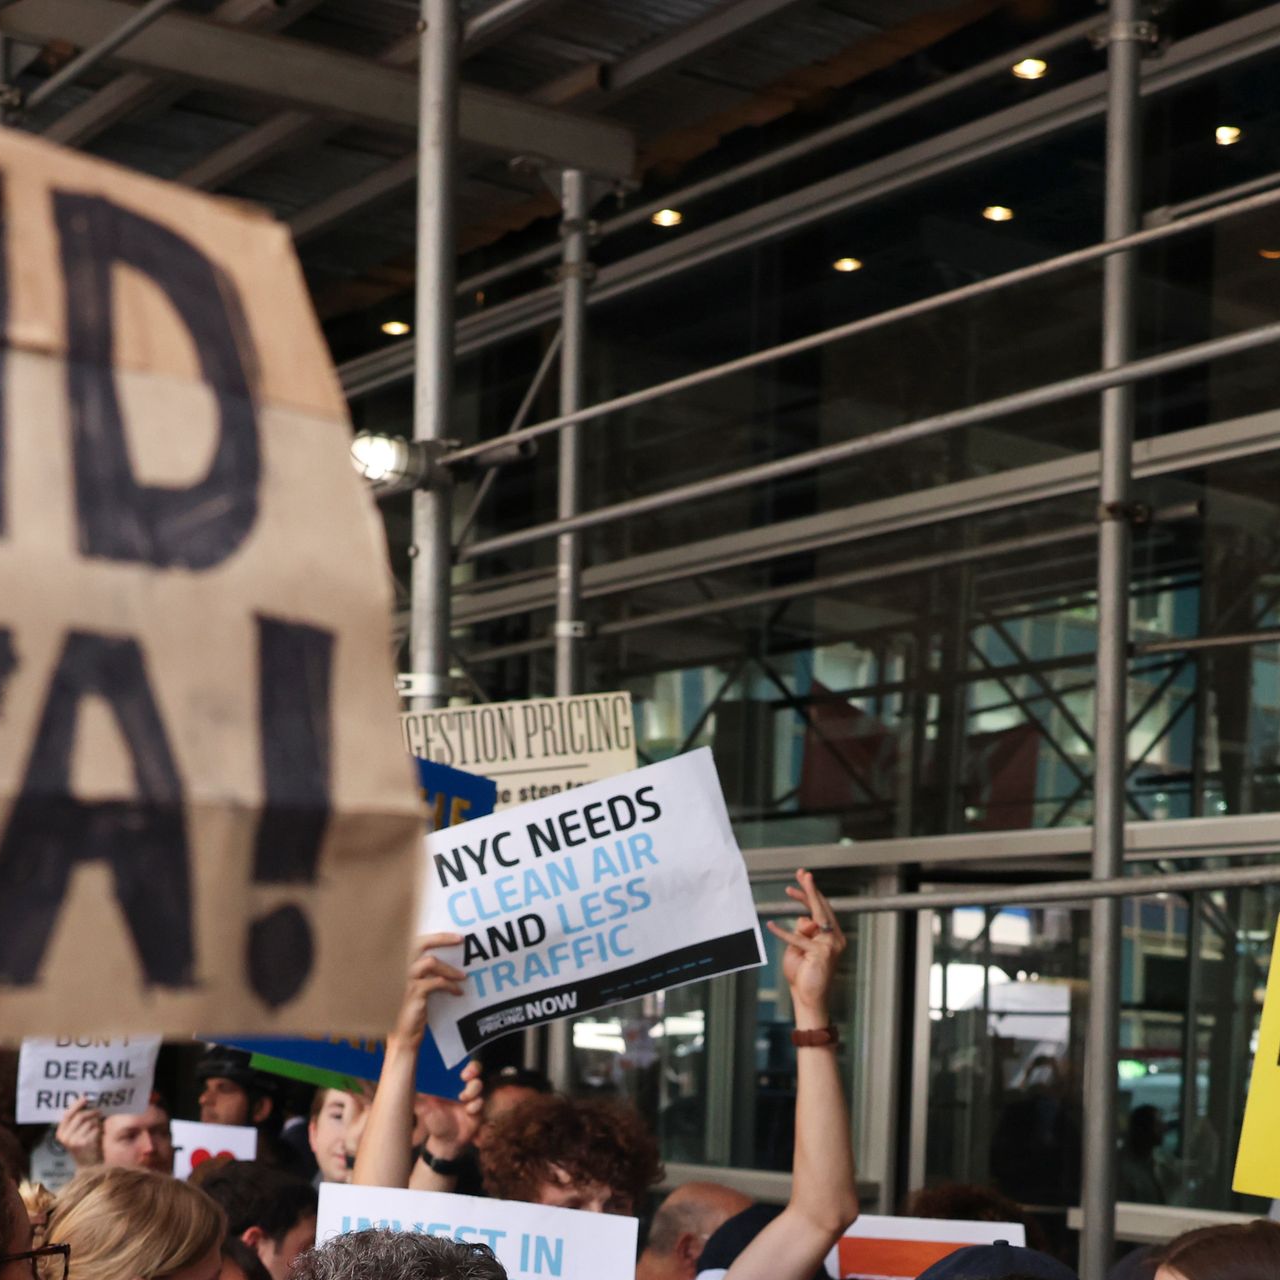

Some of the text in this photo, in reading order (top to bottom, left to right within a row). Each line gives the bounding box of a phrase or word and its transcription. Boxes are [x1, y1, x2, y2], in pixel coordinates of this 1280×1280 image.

[401, 695, 631, 766] GESTION PRICING
[433, 831, 520, 887] NYC
[526, 786, 661, 857] NEEDS
[448, 832, 659, 928] CLEAN AIR
[462, 876, 651, 966] AND LESS
[467, 923, 635, 998] TRAFFIC
[525, 991, 577, 1020] NOW
[44, 1059, 135, 1080] DERAIL
[520, 1233, 564, 1277] IN
